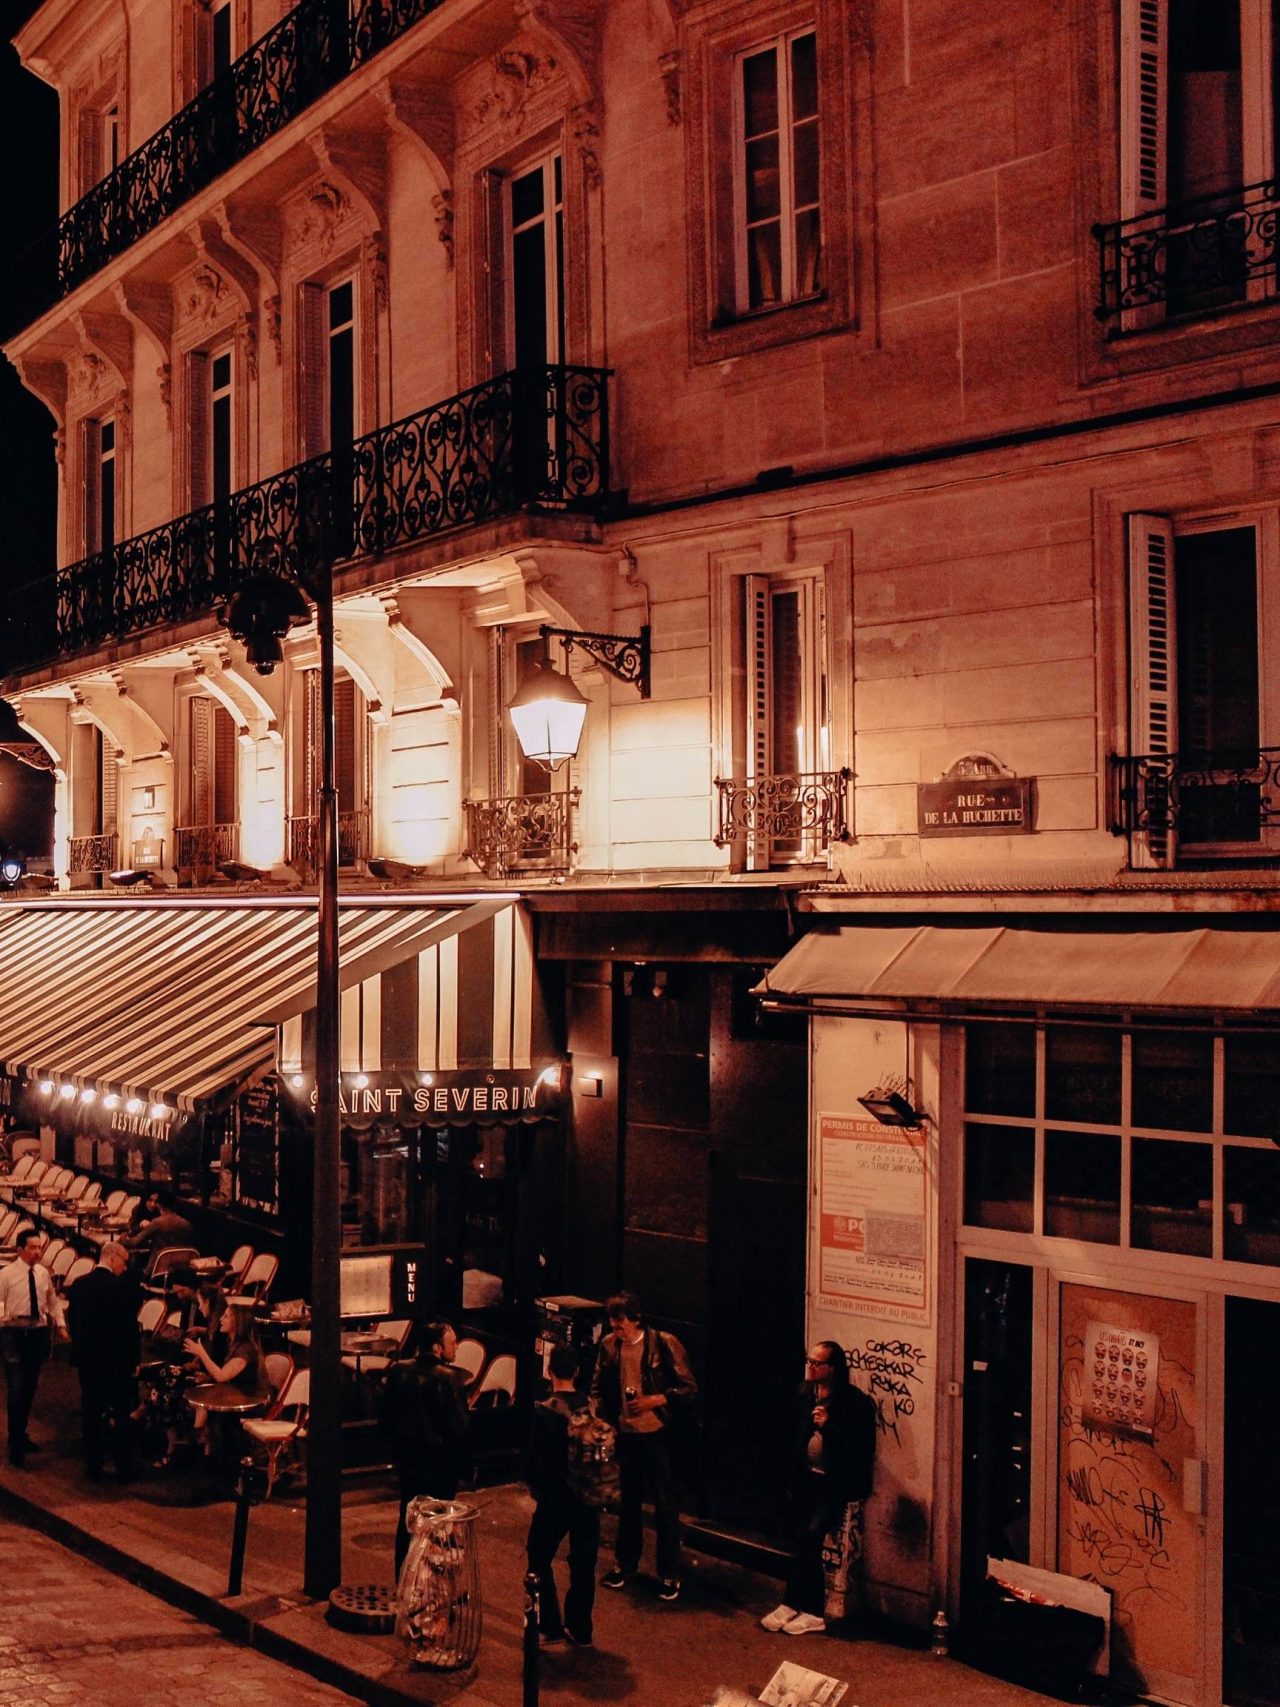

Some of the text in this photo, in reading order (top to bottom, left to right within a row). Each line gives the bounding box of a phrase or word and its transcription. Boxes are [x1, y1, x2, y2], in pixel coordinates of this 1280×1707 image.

[957, 794, 985, 807] RUE
[925, 808, 1024, 825] DE LA HUCHETTE
[414, 1087, 538, 1113] SEVERIN
[112, 1111, 171, 1142] RESTAURANT
[823, 1120, 854, 1130] PERMIS
[856, 1122, 868, 1132] DE
[406, 1263, 416, 1303] MENU
[855, 1302, 887, 1314] INTERDIT
[890, 1308, 899, 1317] AU
[901, 1310, 926, 1320] PUBLIC
